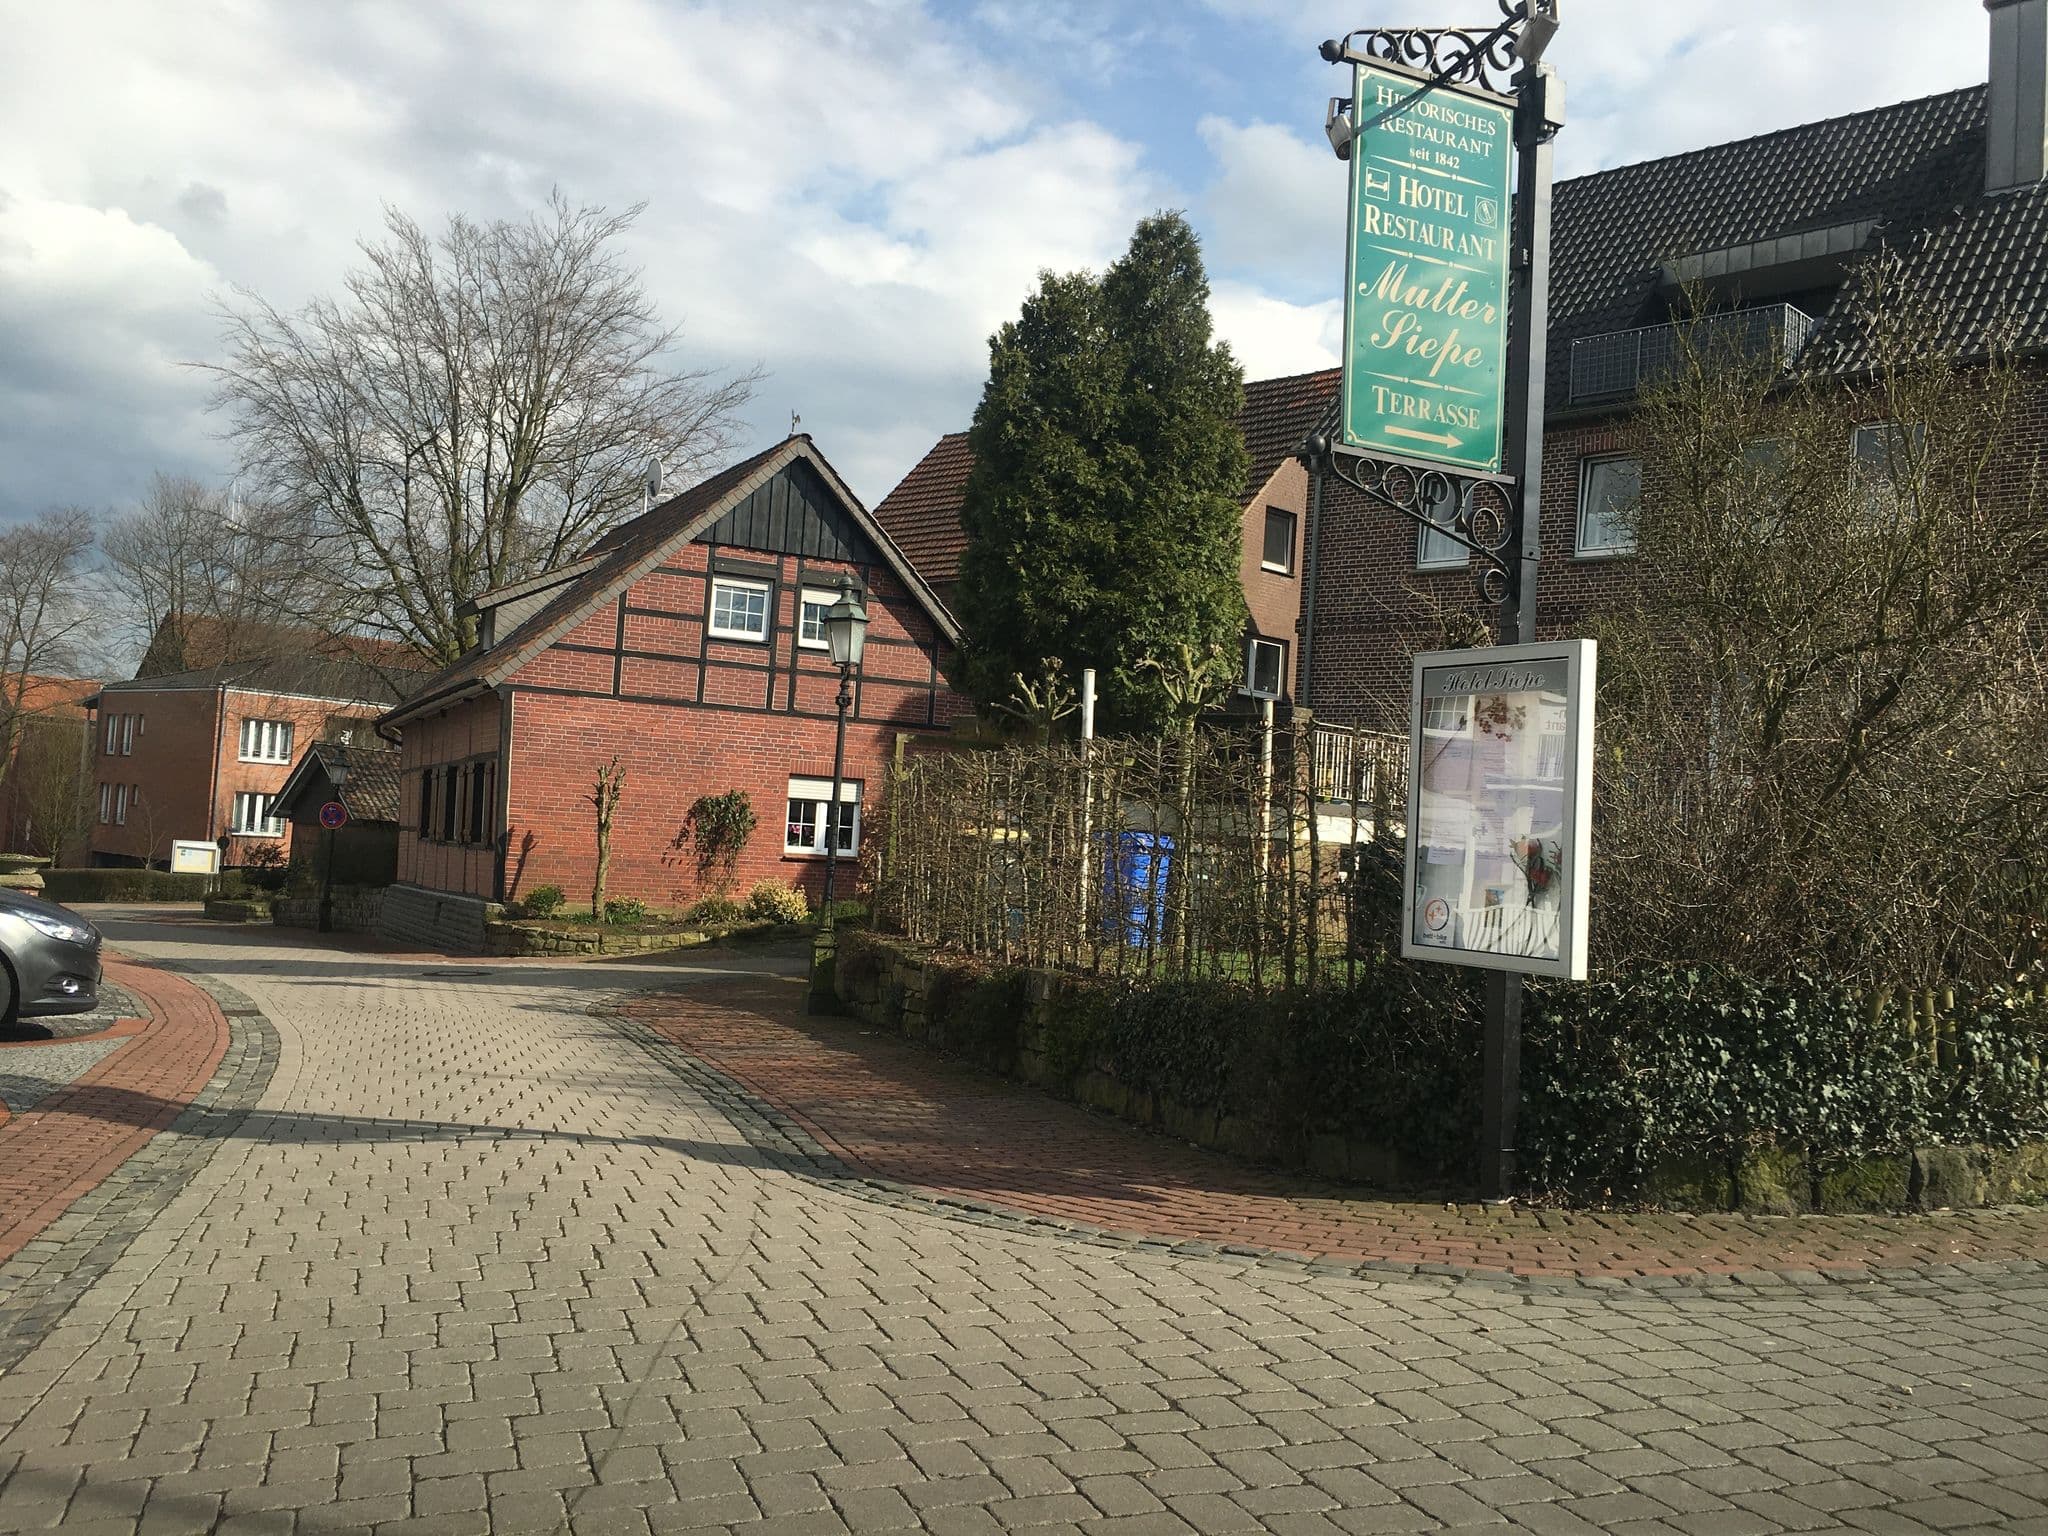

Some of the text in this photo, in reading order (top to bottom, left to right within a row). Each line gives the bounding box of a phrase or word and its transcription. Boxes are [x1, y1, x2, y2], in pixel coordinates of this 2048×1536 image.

[1379, 114, 1493, 157] RESTAURANT
[1409, 147, 1460, 169] seit 1842
[1398, 175, 1469, 218] HOTEL
[1363, 202, 1497, 261] RESTAURANT
[1358, 260, 1497, 324] Mutter
[1370, 309, 1484, 377] Siepe
[1371, 385, 1481, 430] TERRASSE
[1443, 666, 1545, 692] Hotel Siepe
